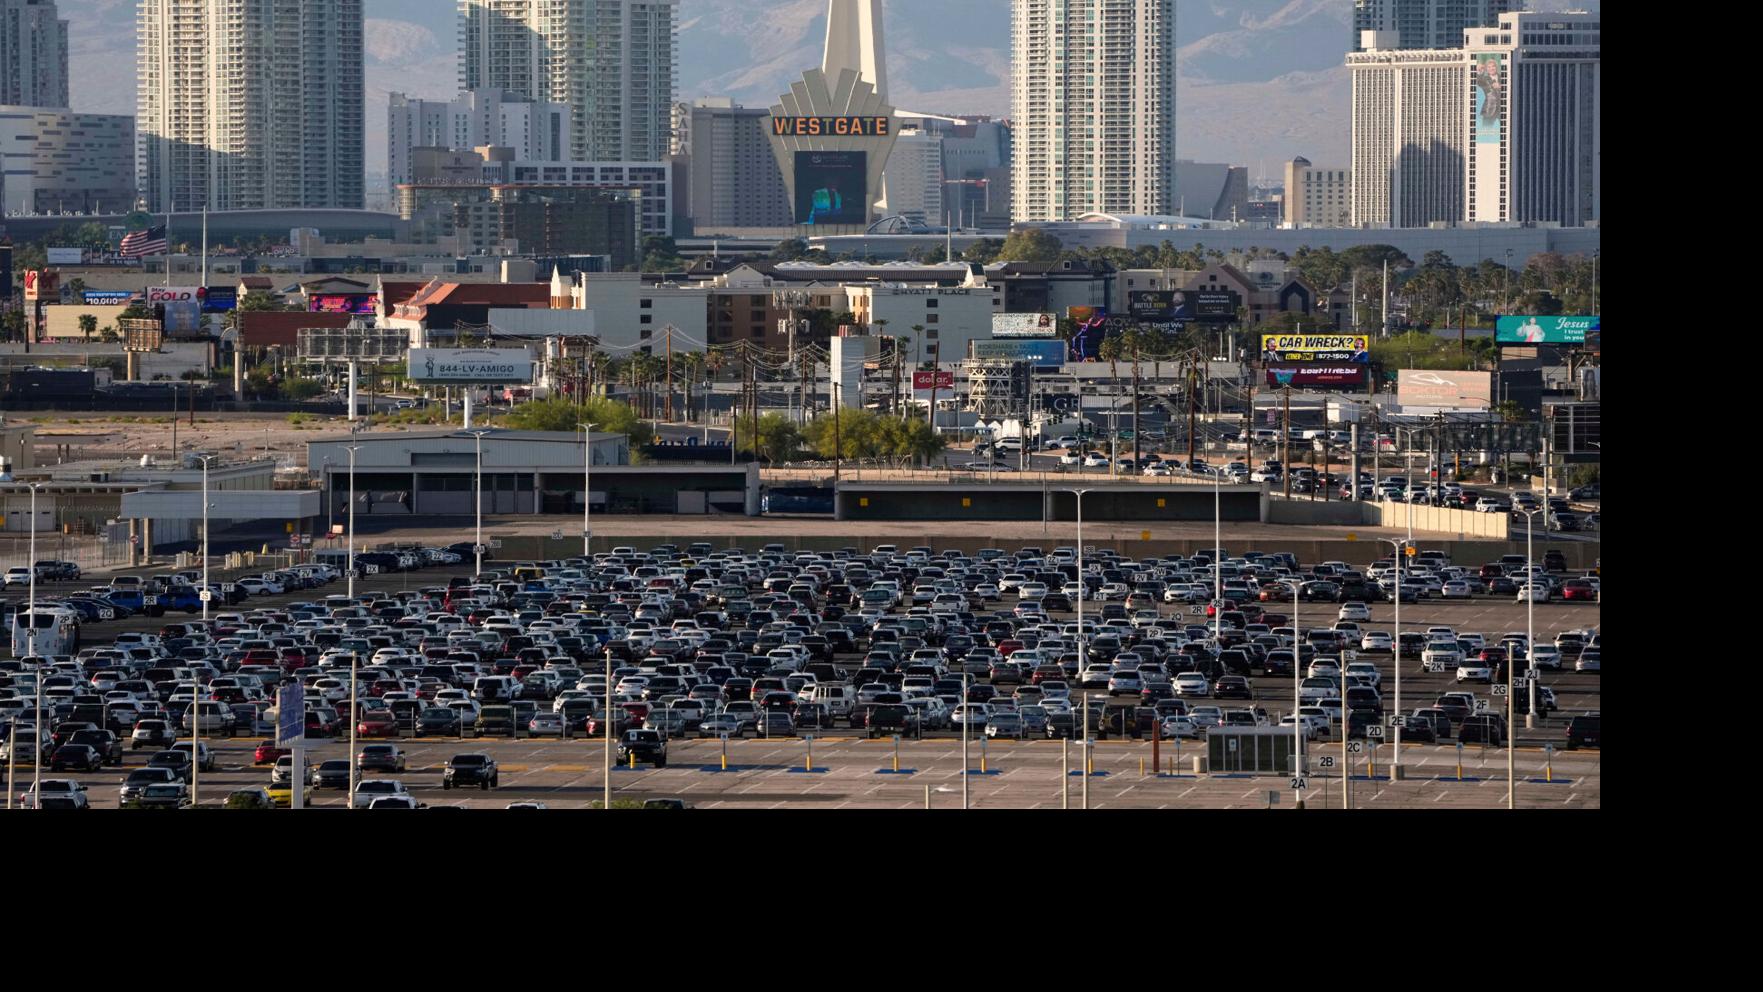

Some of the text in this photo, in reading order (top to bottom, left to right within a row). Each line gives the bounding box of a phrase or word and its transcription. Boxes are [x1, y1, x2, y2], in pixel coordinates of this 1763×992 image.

[774, 117, 886, 134] WESTGATE
[150, 292, 191, 301] GOLD
[1555, 317, 1590, 330] Jesus
[1279, 337, 1353, 348] CAR WRECK?
[439, 365, 514, 373] 844-LV-AMIGO
[918, 375, 949, 383] dolar.
[223, 583, 232, 591] 2T
[101, 610, 113, 618] 2Q
[1192, 606, 1202, 614] 2R
[60, 615, 70, 624] 2P
[26, 629, 37, 637] 2N
[1149, 629, 1159, 638] 2P
[1075, 634, 1087, 642] 2N
[1205, 640, 1217, 649] 2M
[1431, 662, 1443, 671] 2K
[1527, 670, 1538, 679] 2J
[1513, 678, 1524, 687] 2H
[1493, 685, 1506, 694] 2G
[1476, 700, 1487, 709] 2F
[1391, 716, 1404, 726] 2E
[1369, 726, 1382, 736] 2D
[1347, 743, 1360, 752] 2C
[1320, 756, 1334, 767] 2B
[1291, 778, 1306, 789] 2A
